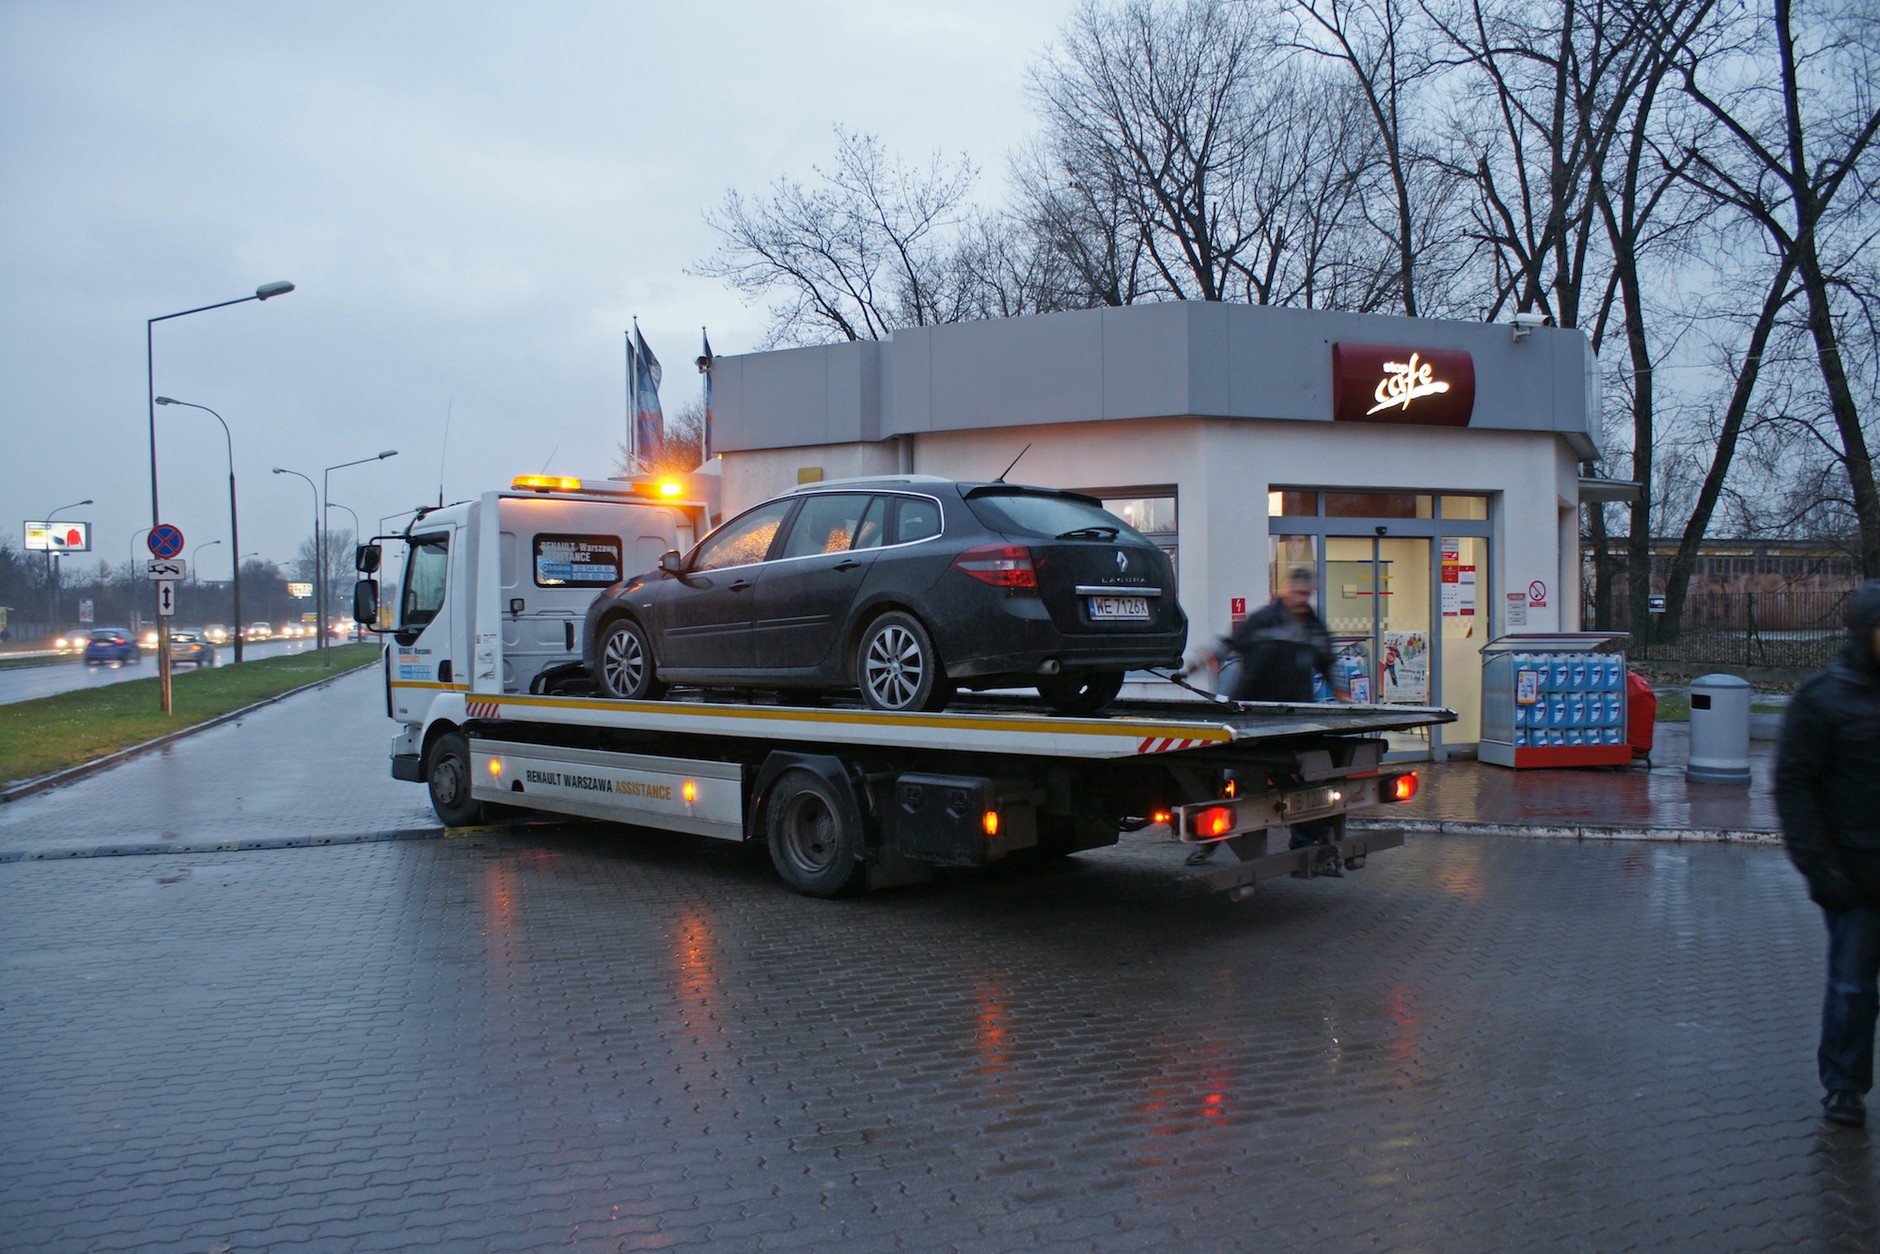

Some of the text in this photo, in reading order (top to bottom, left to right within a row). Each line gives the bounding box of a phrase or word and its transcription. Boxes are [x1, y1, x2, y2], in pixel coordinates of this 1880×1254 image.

[1383, 361, 1409, 374] stop
[540, 541, 618, 553] RENAULT Warszawa
[1095, 598, 1147, 614] WE 7126X
[526, 769, 672, 801] RENAULT WARSZAWA ASSISTANCE
